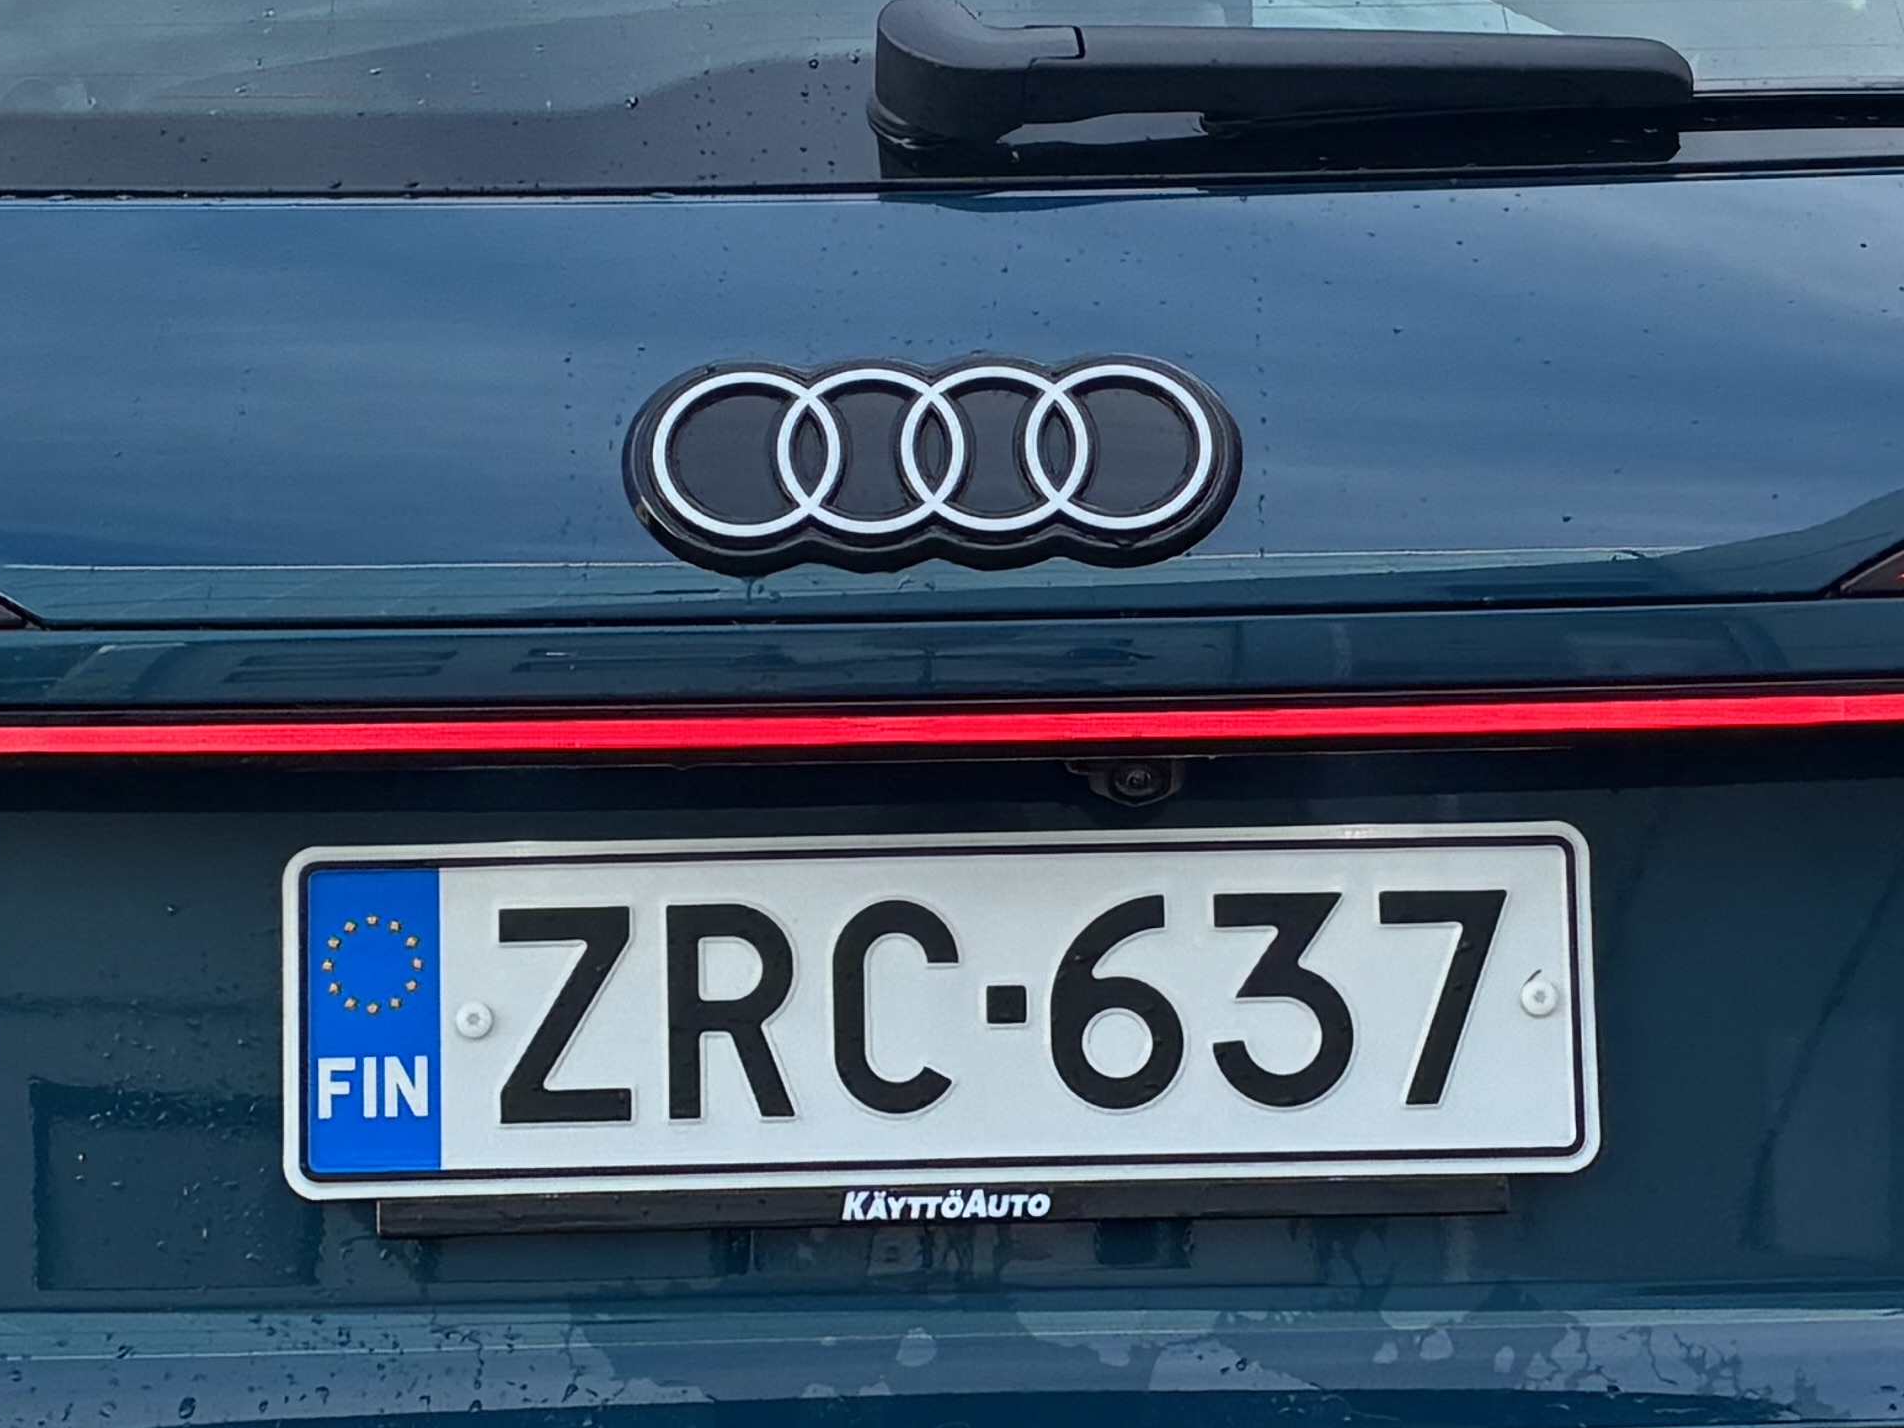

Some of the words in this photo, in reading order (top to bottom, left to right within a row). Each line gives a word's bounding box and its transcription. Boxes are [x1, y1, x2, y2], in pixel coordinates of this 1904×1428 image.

[497, 887, 1507, 1124] ZRC-637
[317, 1055, 429, 1120] FIN
[842, 1188, 1052, 1221] KÄYTTÖAUTO
